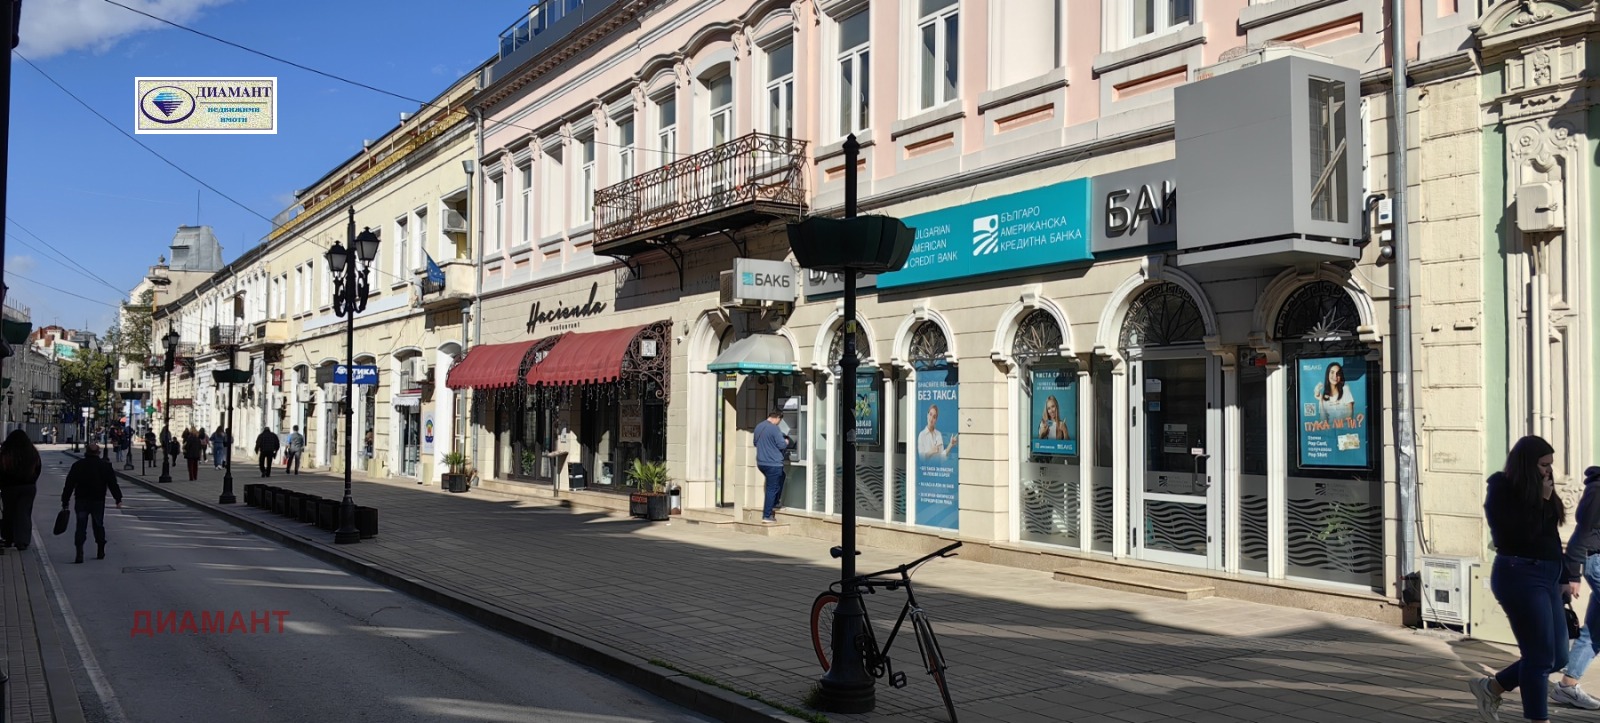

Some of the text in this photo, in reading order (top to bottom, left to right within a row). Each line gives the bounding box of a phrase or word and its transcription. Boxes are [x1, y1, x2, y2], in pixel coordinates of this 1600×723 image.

[1001, 206, 1040, 223] БЪЛГАРО
[1105, 180, 1177, 238] БАК
[914, 223, 951, 240] ULGARIAN
[1001, 216, 1067, 237] АМЕРИКАНСКА
[911, 239, 947, 254] AMERICAN
[1001, 229, 1082, 252] КРЕДИТНА БАНКА
[909, 251, 958, 268] CREDIT BANK
[754, 273, 790, 288] БАКБ
[526, 281, 607, 335] Hacienda
[550, 321, 580, 332] restaurant
[918, 390, 957, 401] БЕЗ ТАКСА
[1304, 420, 1330, 432] ПУКА
[1333, 418, 1345, 429] ЛИ
